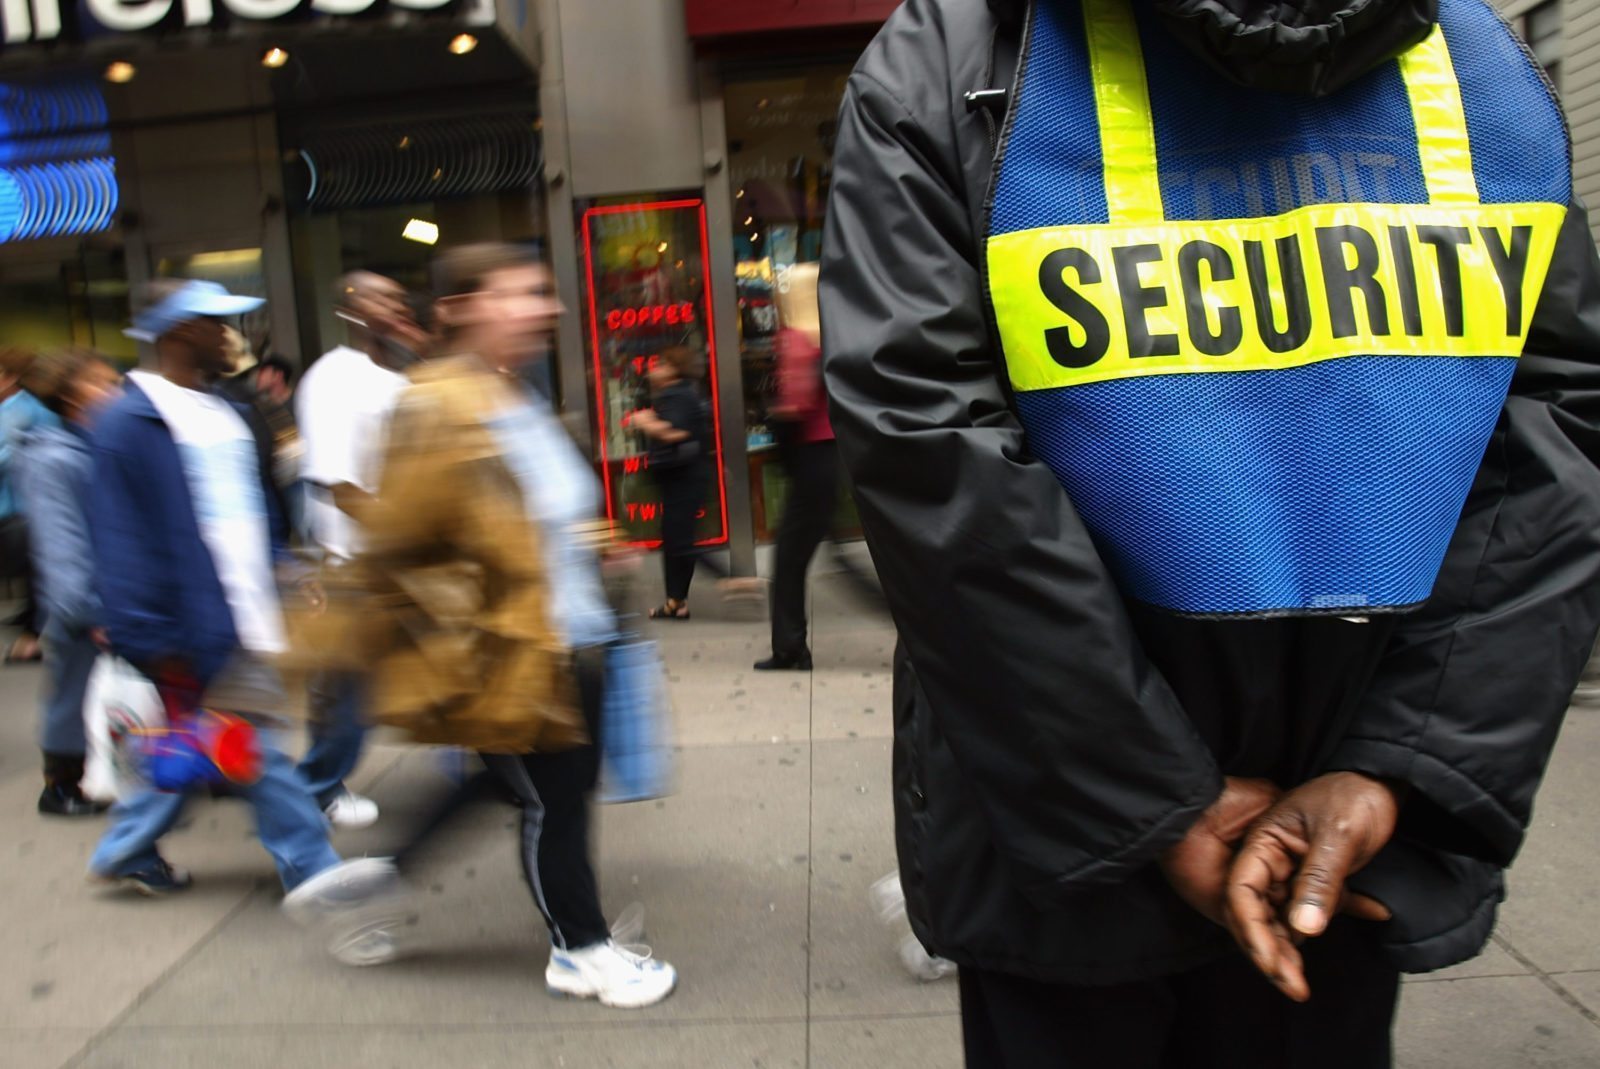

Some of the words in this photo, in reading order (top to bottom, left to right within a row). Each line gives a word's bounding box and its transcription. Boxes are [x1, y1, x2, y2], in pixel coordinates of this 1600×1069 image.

[1038, 224, 1532, 369] SECURITY
[607, 302, 695, 331] COFFEE
[631, 354, 661, 376] TE
